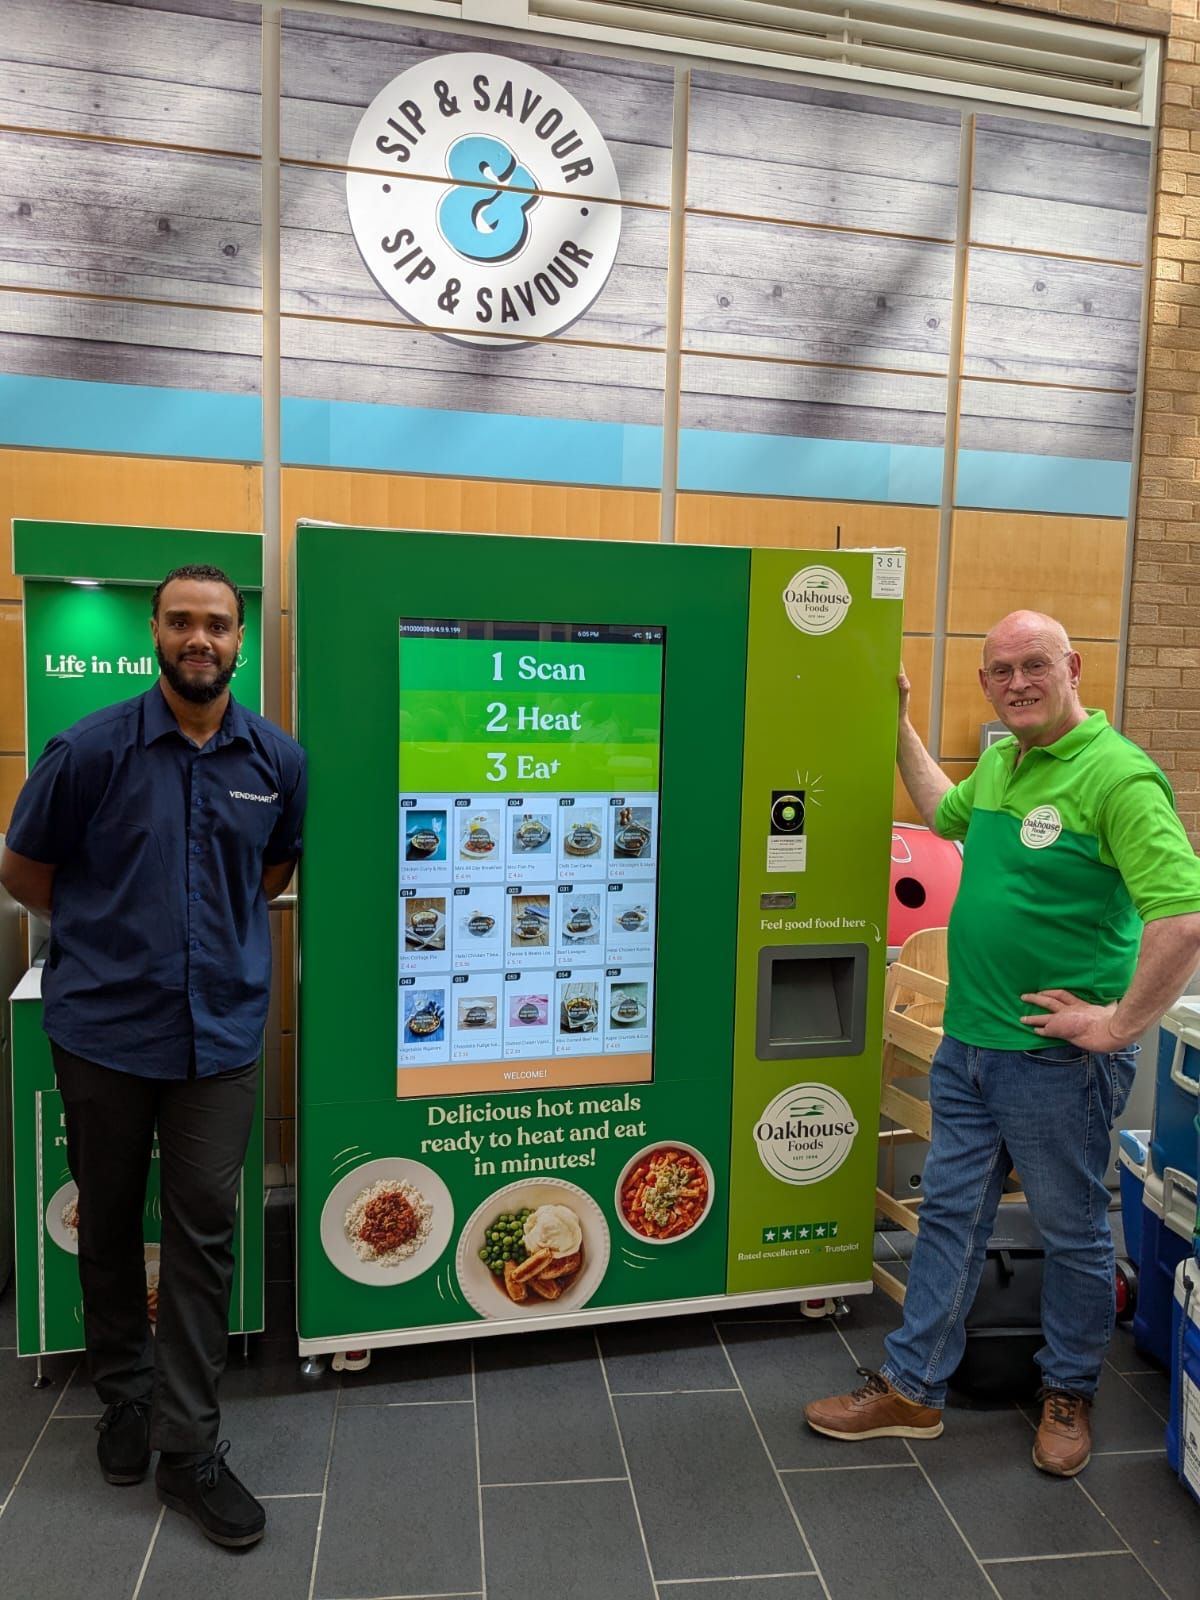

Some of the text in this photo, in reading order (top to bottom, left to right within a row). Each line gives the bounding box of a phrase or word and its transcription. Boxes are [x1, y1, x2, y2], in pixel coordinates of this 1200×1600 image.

[375, 74, 595, 184] SIP & SAVOUR
[380, 228, 595, 324] SIP & SAVOUR
[784, 589, 850, 605] Oakhouse
[804, 603, 829, 613] Foods
[44, 653, 153, 675] Life in full
[491, 652, 586, 681] 1 Scan
[486, 702, 582, 732] 2 Heat
[486, 752, 561, 782] 3 Eat
[229, 790, 273, 804] VENDSMART
[1024, 818, 1061, 832] Oakhouse
[760, 916, 867, 931] Feel good food here
[503, 1069, 547, 1081] WELCOME!
[427, 1092, 641, 1126] Delicious hot meals
[420, 1119, 647, 1155] ready to heat and eat
[756, 1120, 855, 1142] Oakhouse
[787, 1139, 824, 1152] Foods
[474, 1147, 597, 1176] in minutes!
[737, 1250, 761, 1262] Rated
[762, 1247, 799, 1259] excellent
[824, 1243, 860, 1254] Trustpilot
